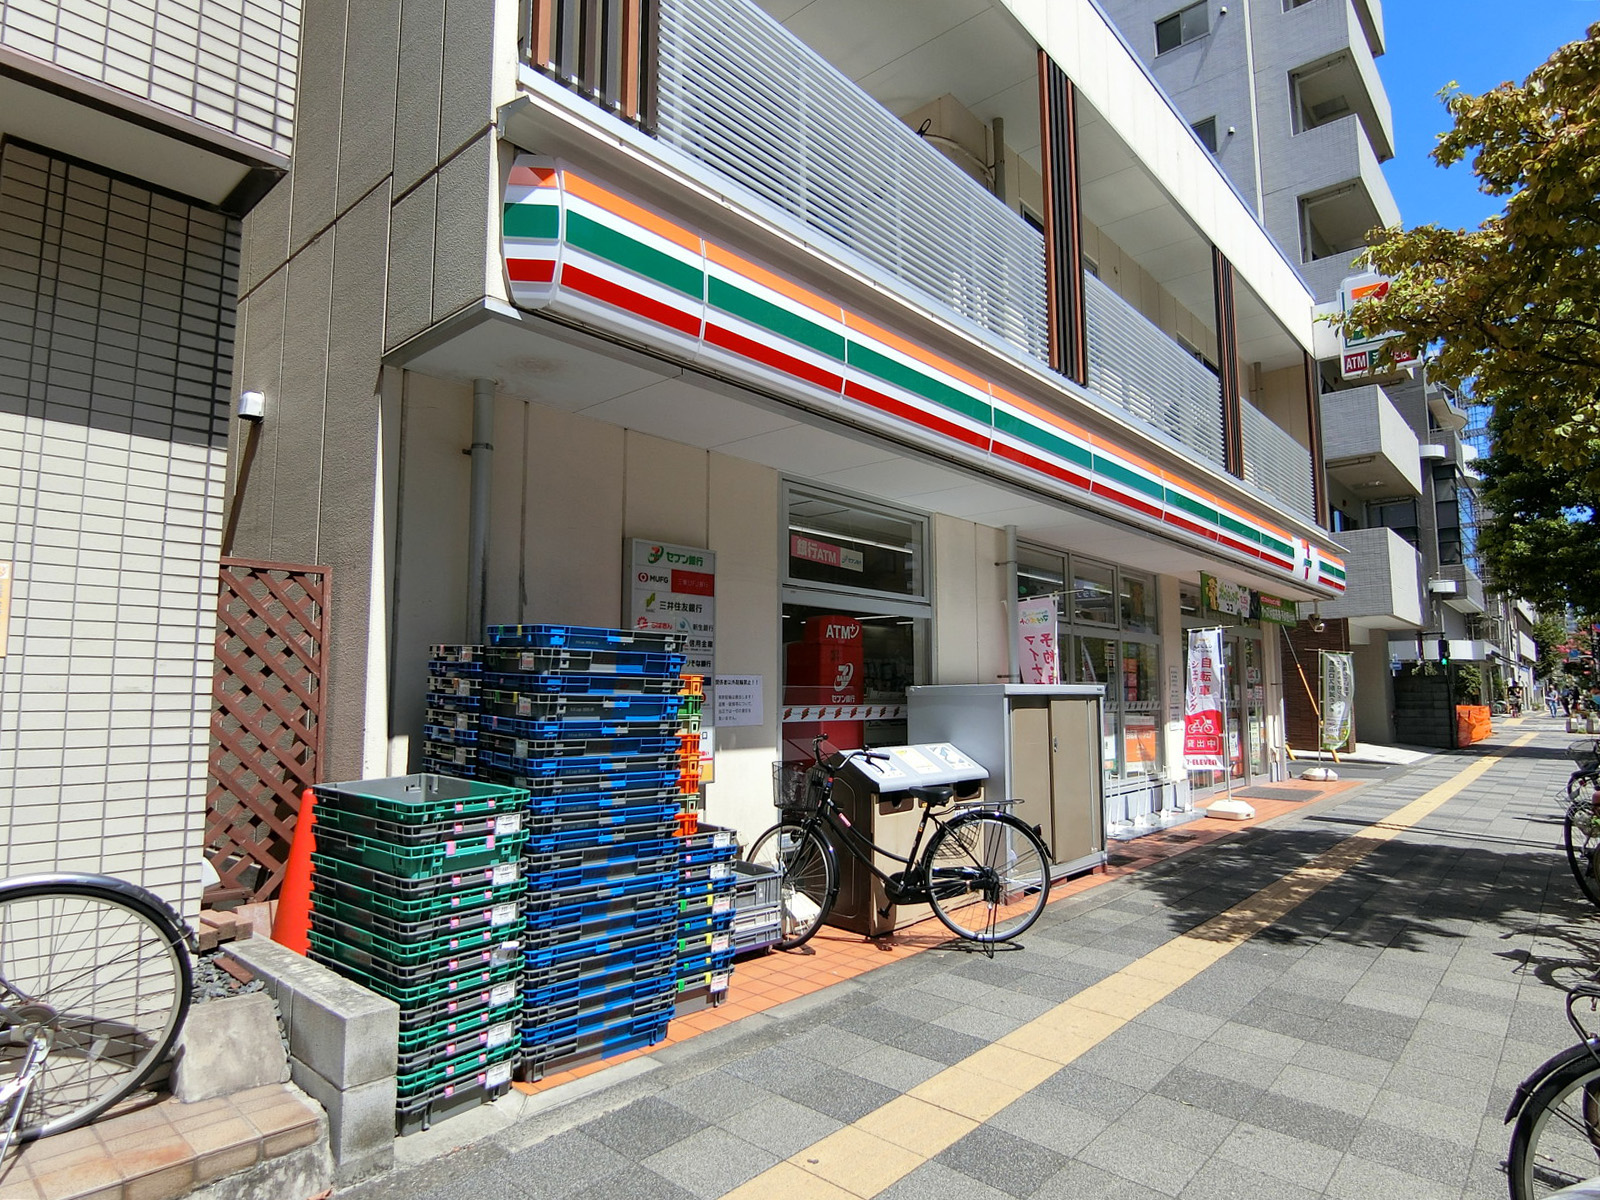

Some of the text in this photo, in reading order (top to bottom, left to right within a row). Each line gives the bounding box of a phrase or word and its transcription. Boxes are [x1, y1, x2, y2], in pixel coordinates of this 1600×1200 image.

[1346, 354, 1367, 371] ATM
[796, 539, 837, 564] 銀行ATM
[666, 552, 704, 566] セブン銀行
[649, 575, 669, 583] MUFG
[659, 600, 703, 613] 三井住友銀行
[689, 639, 713, 648] 信用金庫
[1199, 657, 1212, 696] 自転車
[831, 695, 855, 703] セブン銀行
[1186, 739, 1217, 748] 貸出中
